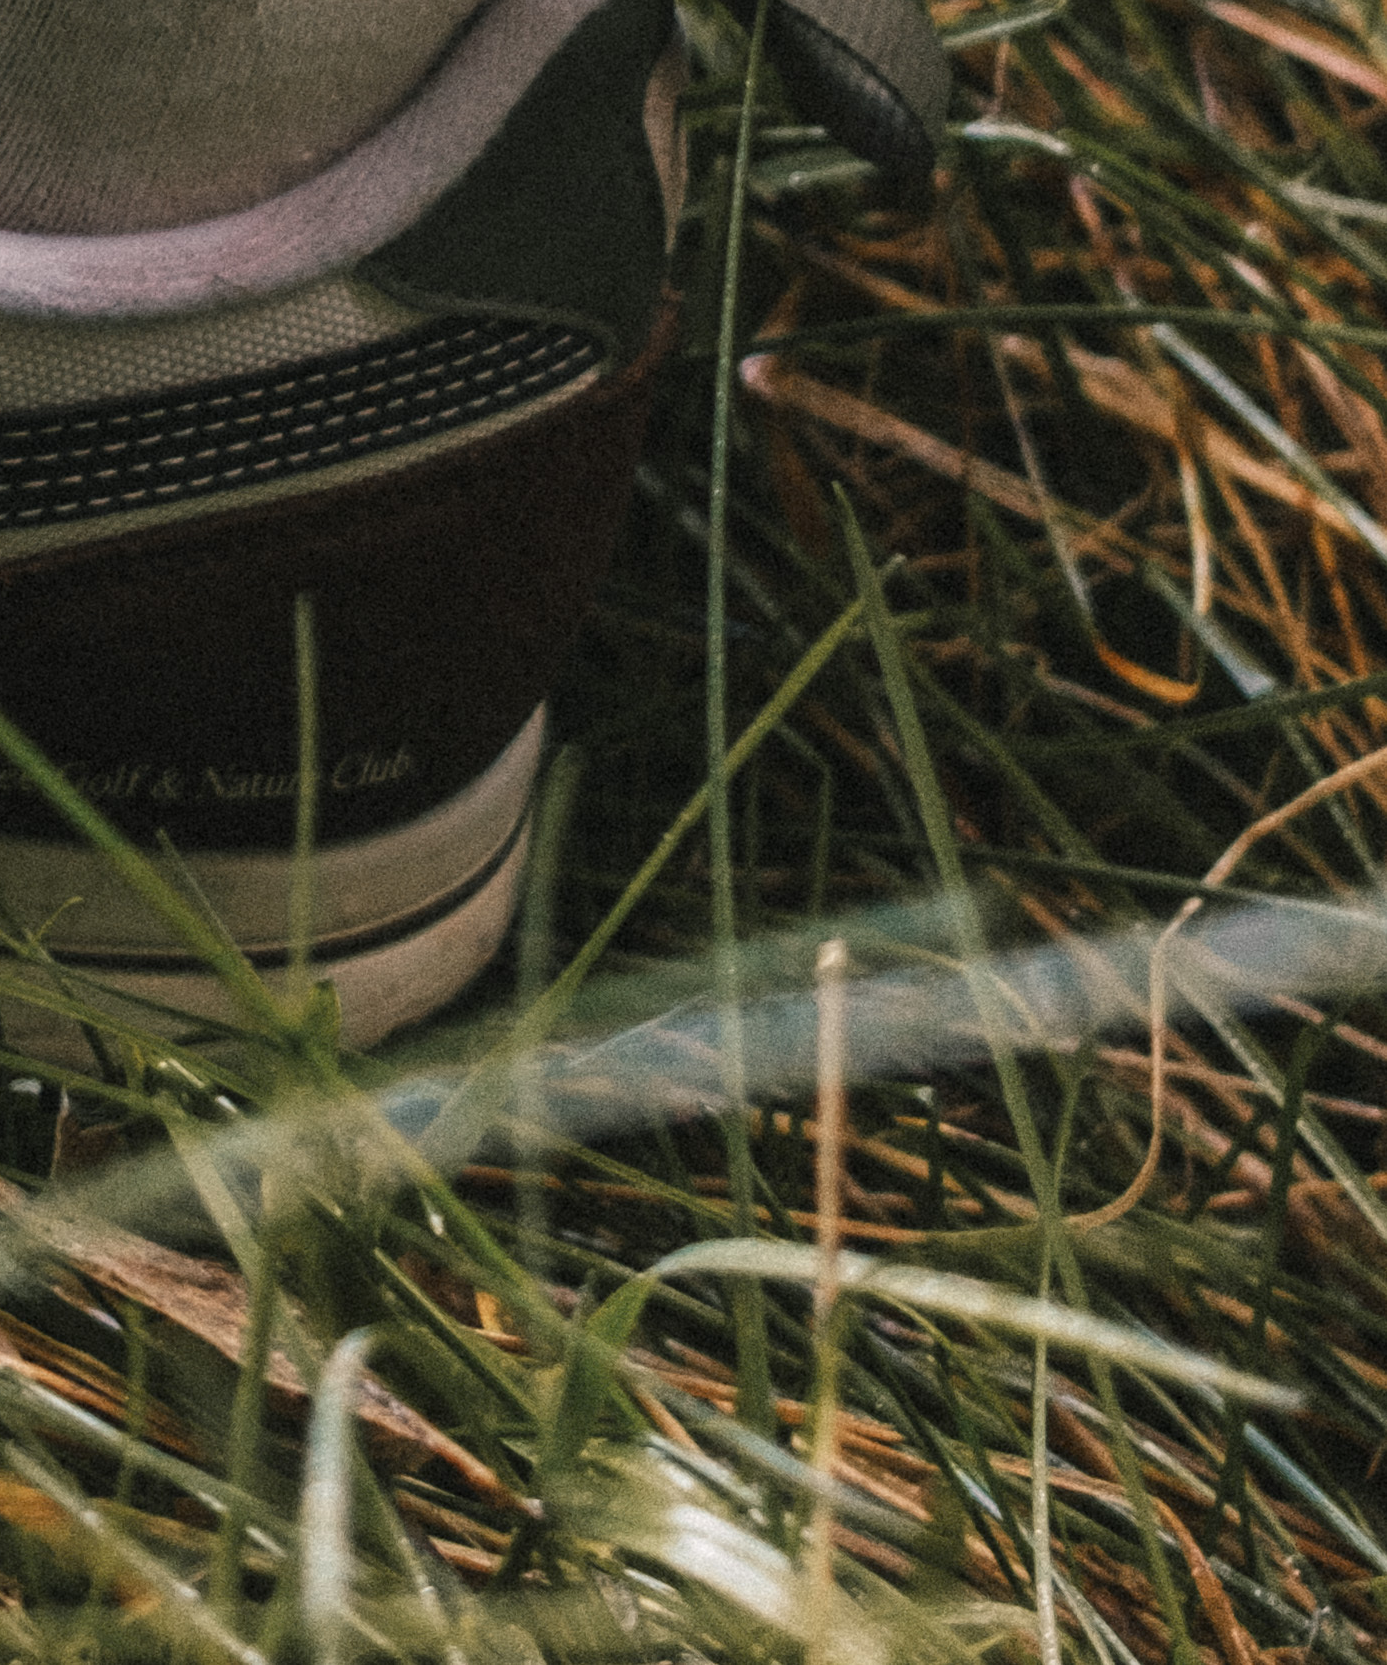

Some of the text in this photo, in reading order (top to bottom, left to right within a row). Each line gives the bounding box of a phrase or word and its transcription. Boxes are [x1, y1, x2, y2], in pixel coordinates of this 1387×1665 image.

[151, 765, 180, 801] &
[195, 764, 313, 801] Natur
[330, 745, 411, 791] Club
